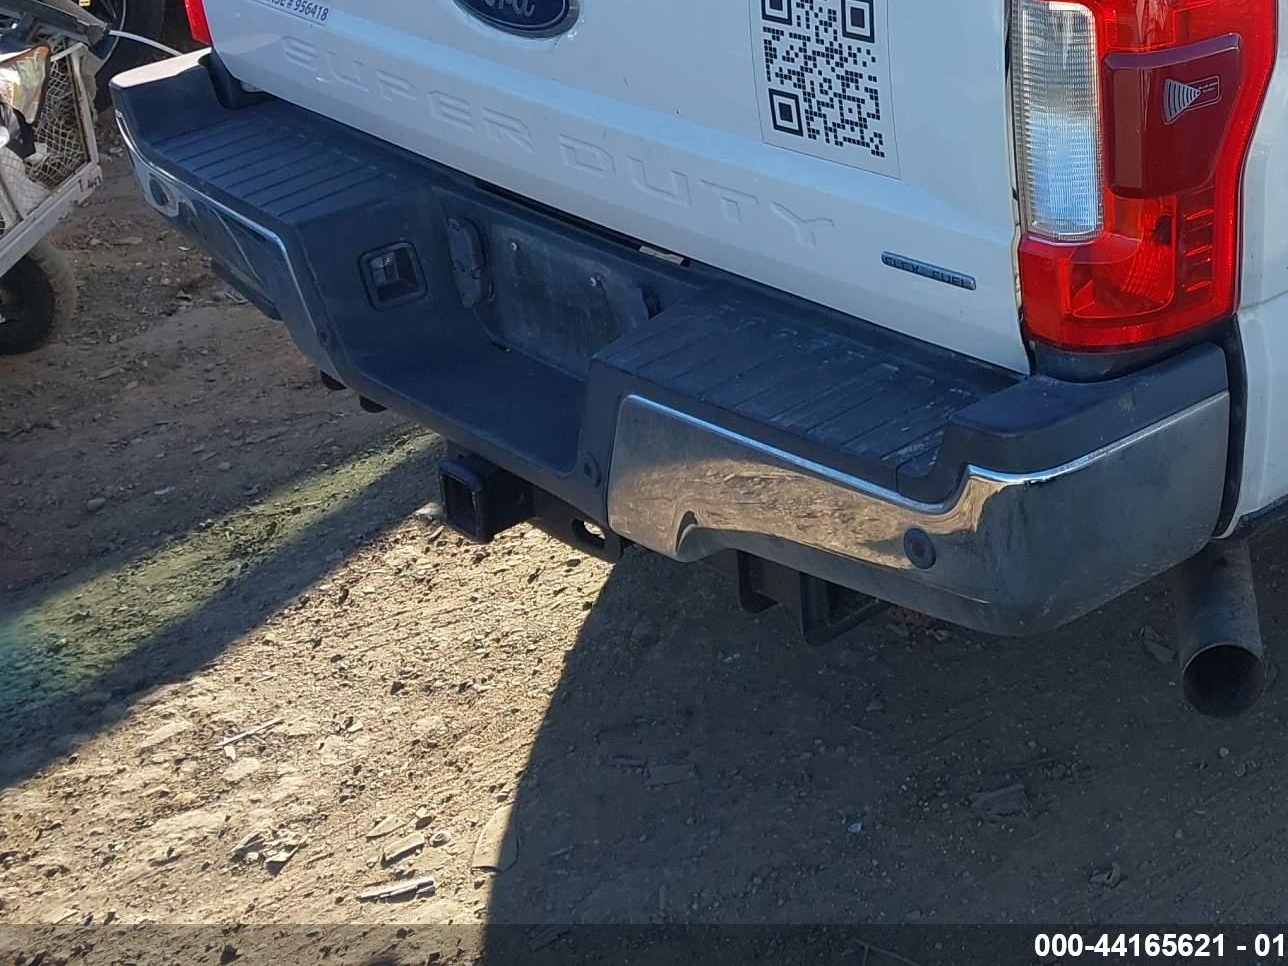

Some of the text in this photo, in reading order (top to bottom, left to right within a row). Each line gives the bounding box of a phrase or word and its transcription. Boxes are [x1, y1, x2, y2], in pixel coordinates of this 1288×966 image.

[283, 34, 835, 248] SUPER DUTY
[884, 256, 971, 290] FLEX FUEL
